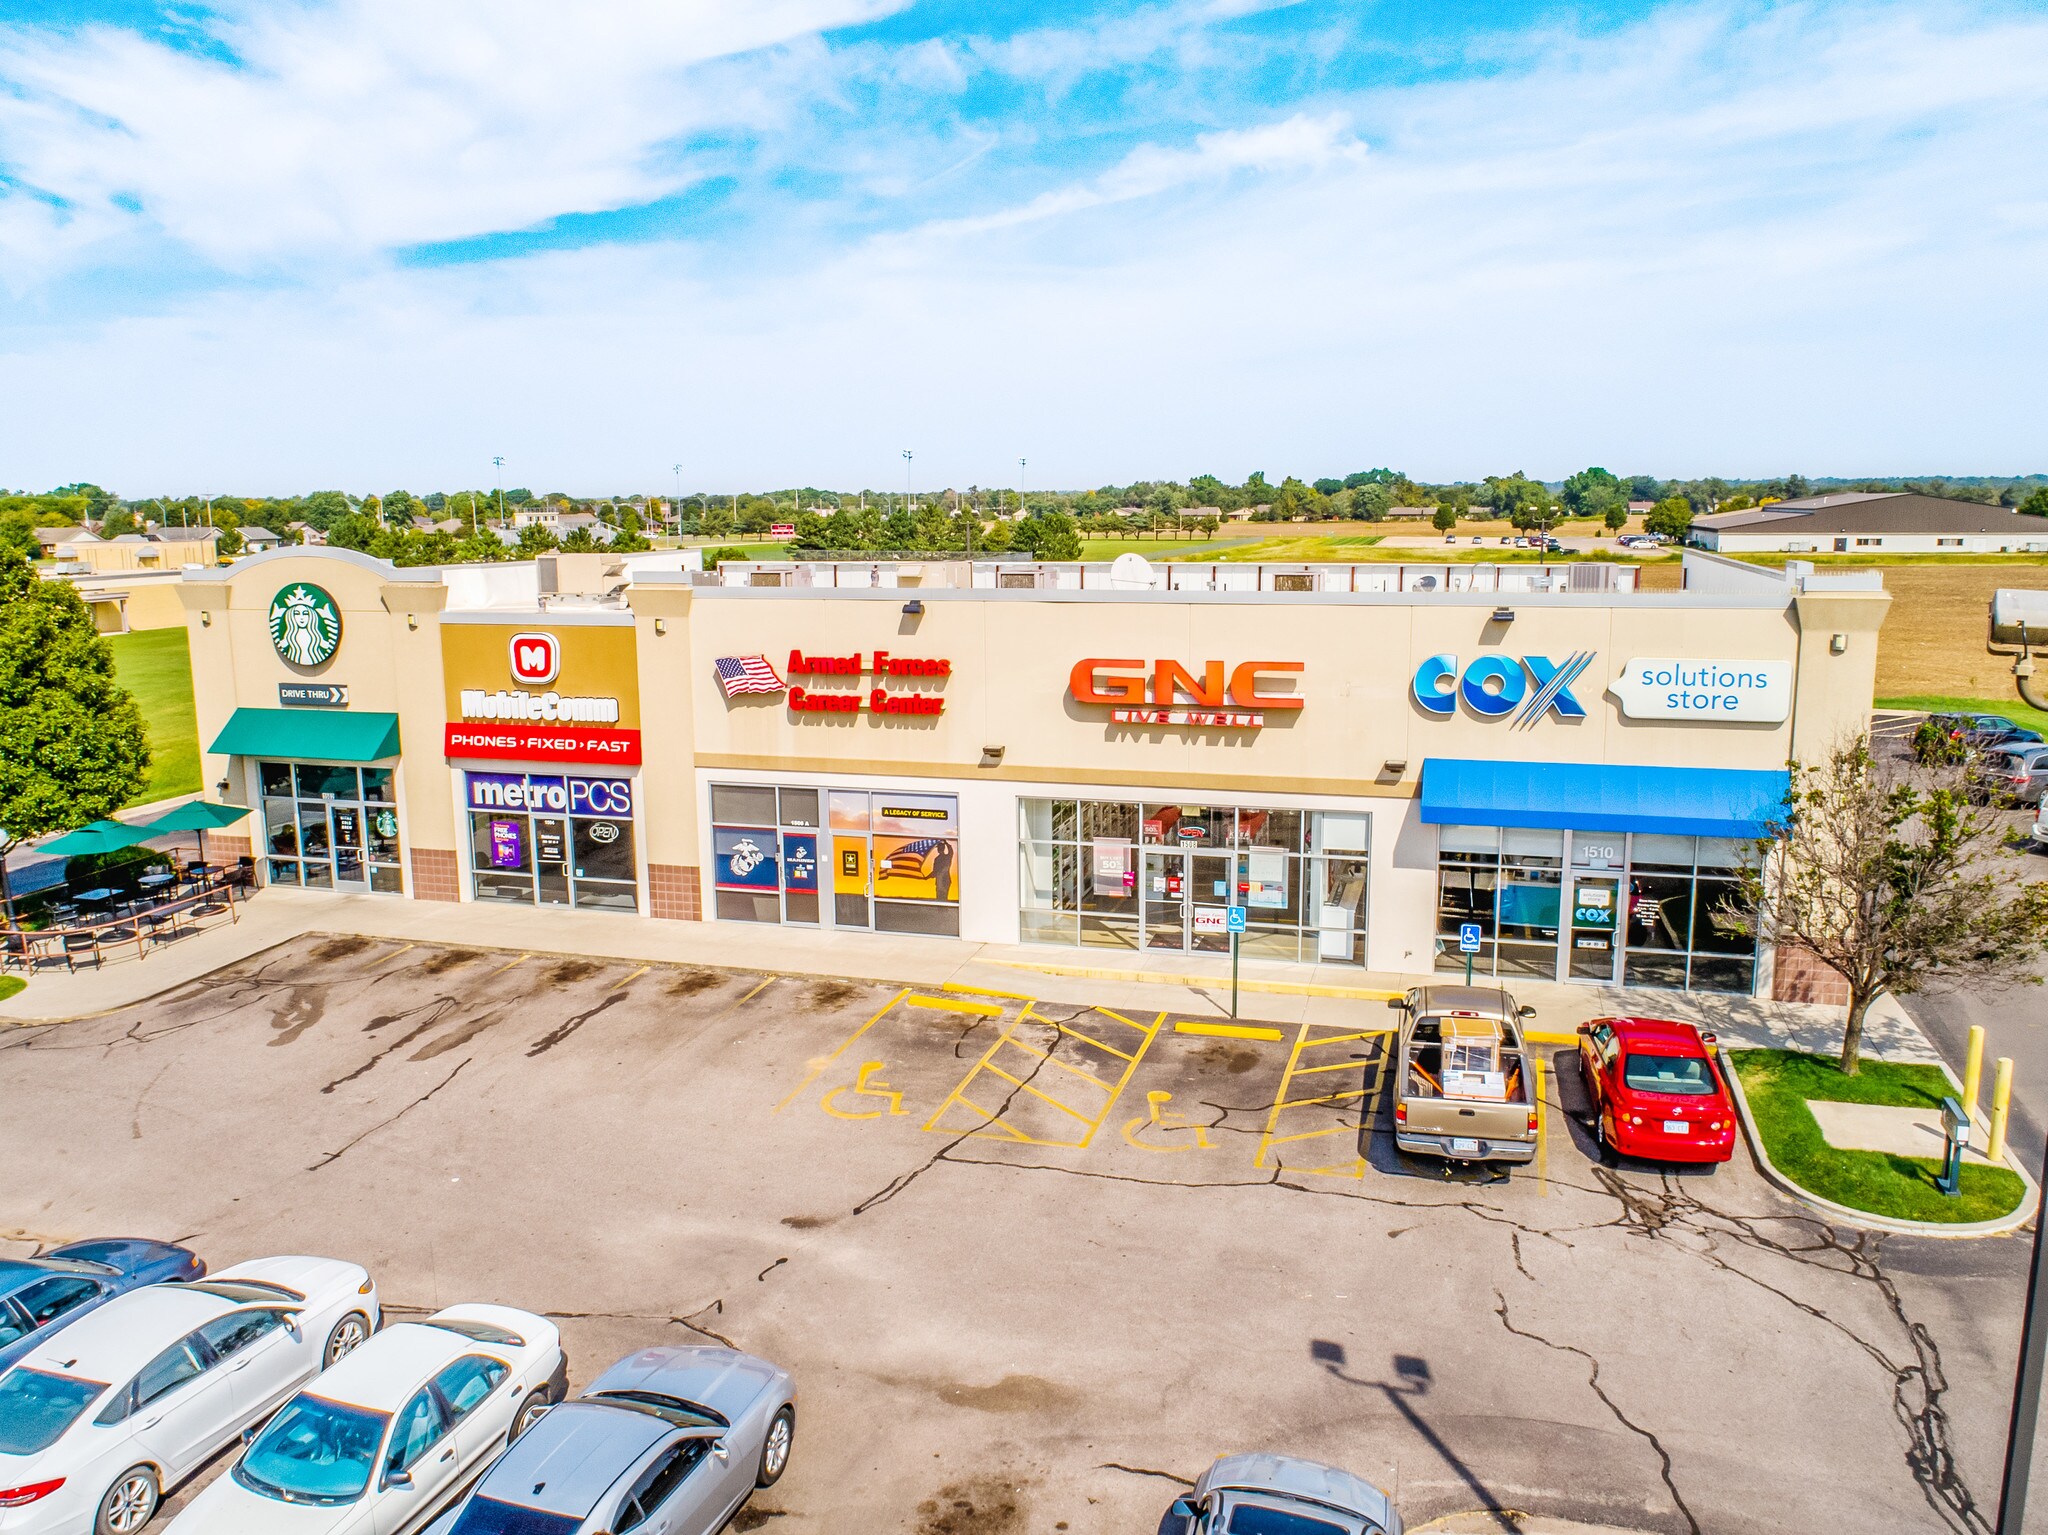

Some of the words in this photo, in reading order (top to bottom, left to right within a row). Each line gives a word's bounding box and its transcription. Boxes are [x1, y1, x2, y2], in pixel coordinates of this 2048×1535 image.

[519, 645, 546, 672] M
[787, 649, 861, 675] Armed
[873, 651, 951, 676] Forces
[1070, 658, 1305, 708] GNC
[1641, 663, 1768, 689] solutions
[281, 689, 306, 698] DRIVE
[307, 690, 329, 699] THRU
[788, 686, 862, 712] Career
[870, 689, 945, 714] Center
[1412, 651, 1598, 732] COX
[1666, 690, 1739, 710] store
[460, 690, 619, 722] MobileComm
[1111, 709, 1170, 725] LIVE
[1187, 713, 1263, 728] WELL
[451, 734, 517, 747] PHONES
[527, 738, 577, 750] FIXED
[586, 740, 631, 752] FAST
[592, 826, 616, 838] OPEN
[1179, 828, 1204, 838] OPEN
[1583, 846, 1614, 859] 1510
[1576, 908, 1611, 923] COX
